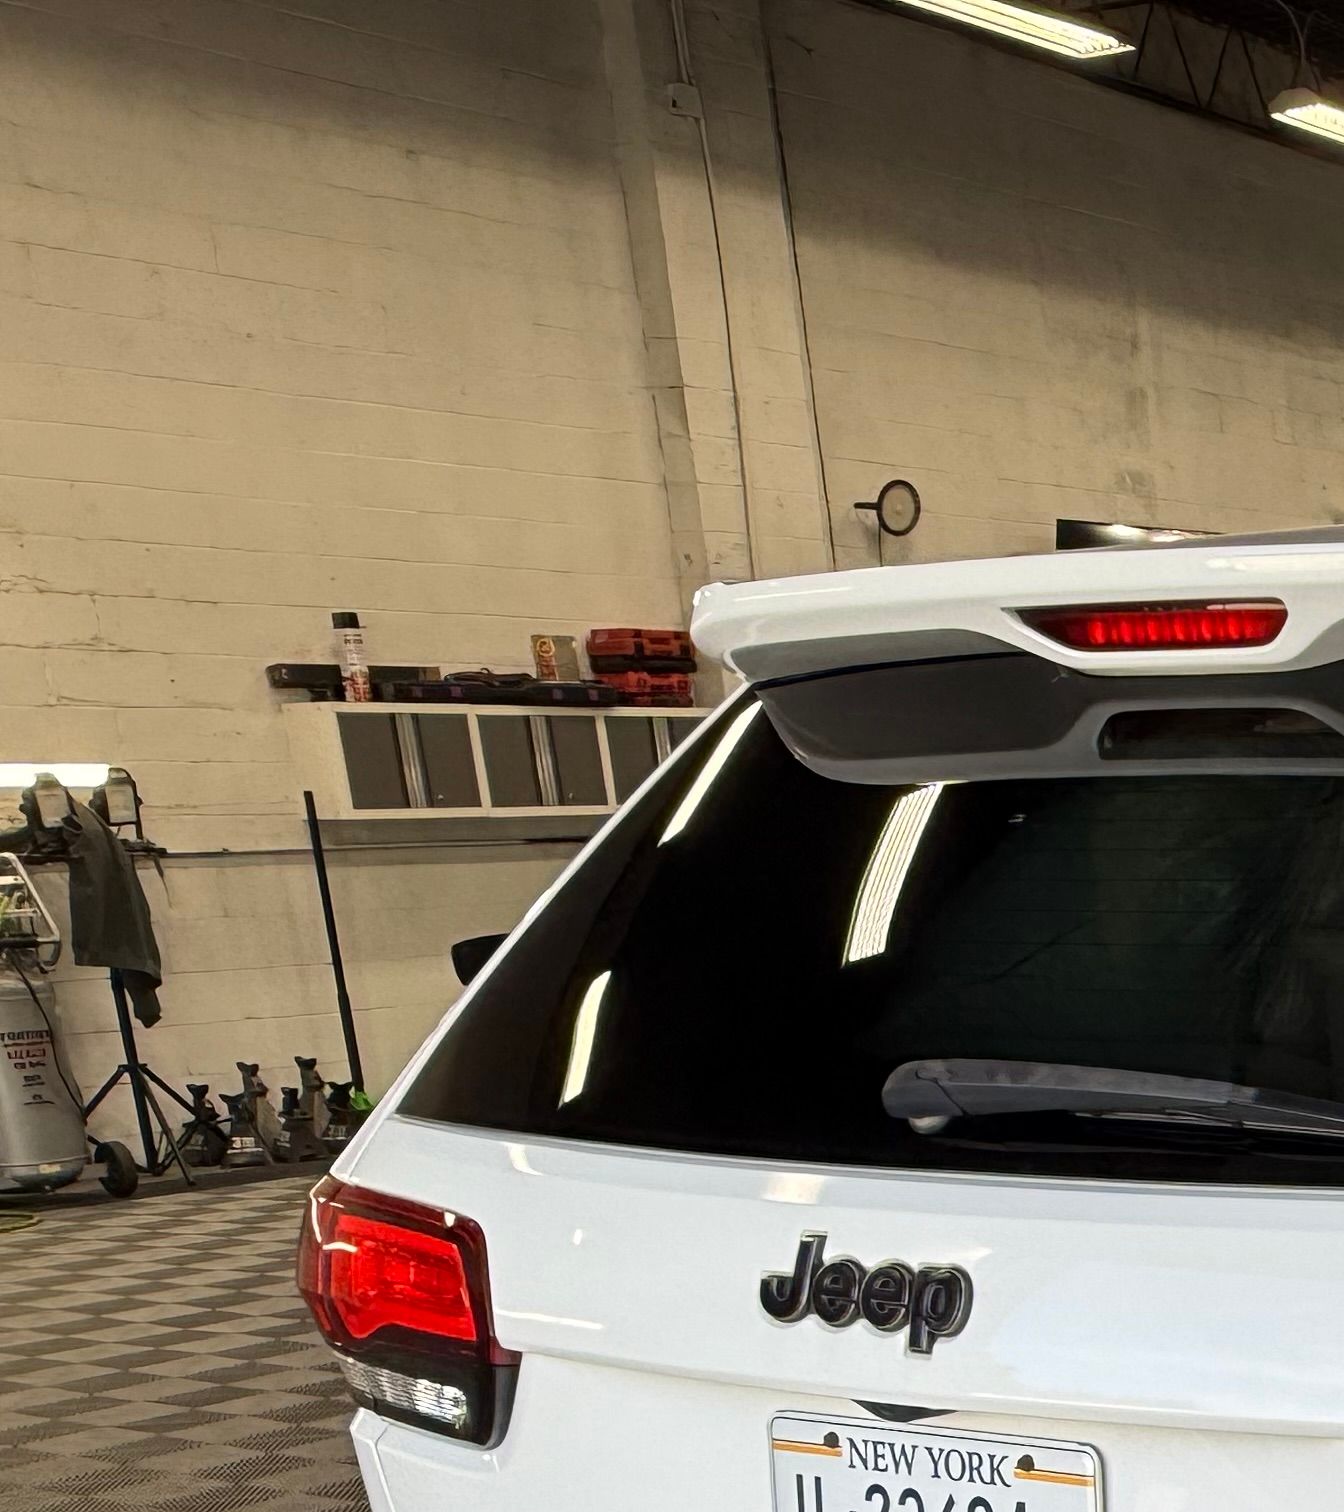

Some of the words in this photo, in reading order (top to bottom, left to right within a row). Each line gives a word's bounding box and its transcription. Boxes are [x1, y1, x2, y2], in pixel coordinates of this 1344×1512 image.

[760, 1230, 974, 1358] Jeep
[846, 1437, 919, 1477] NEW
[926, 1448, 1012, 1488] YORK
